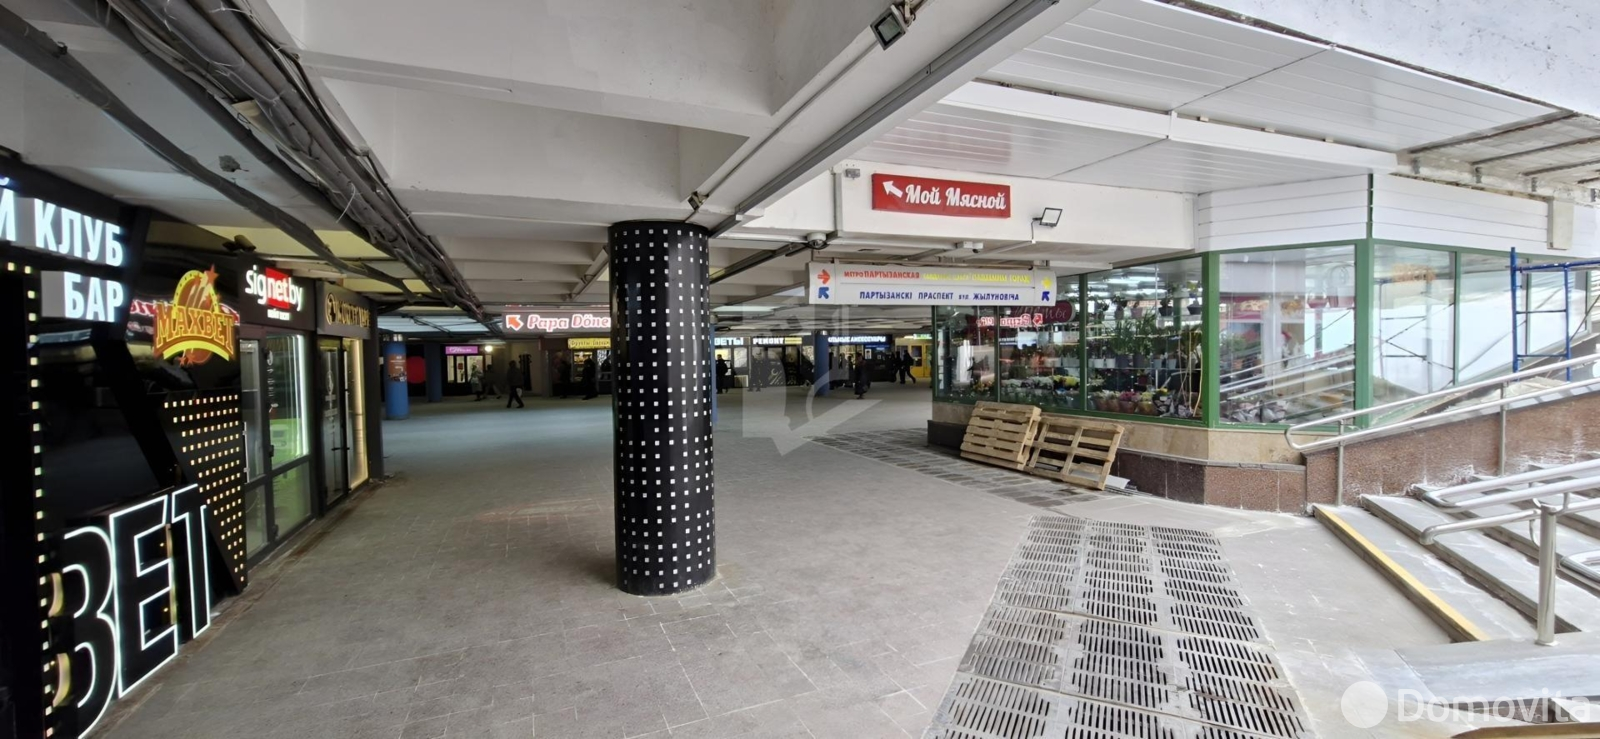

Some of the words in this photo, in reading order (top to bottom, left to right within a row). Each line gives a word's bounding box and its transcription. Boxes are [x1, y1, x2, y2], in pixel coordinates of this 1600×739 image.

[905, 184, 941, 206] Мой
[945, 187, 1007, 210] Мясной
[34, 198, 124, 267] КЛУБ
[64, 271, 124, 323] БАР
[859, 290, 913, 300] ПАРТЫЗАНСКІ
[918, 292, 954, 301] ПРАСПЕКТ
[972, 292, 1020, 301] ЖЫЛУНОВІЧА
[155, 302, 236, 356] MAXBET
[527, 314, 570, 332] Papa
[571, 313, 611, 328] Döne
[714, 337, 744, 346] ВЕТЫ
